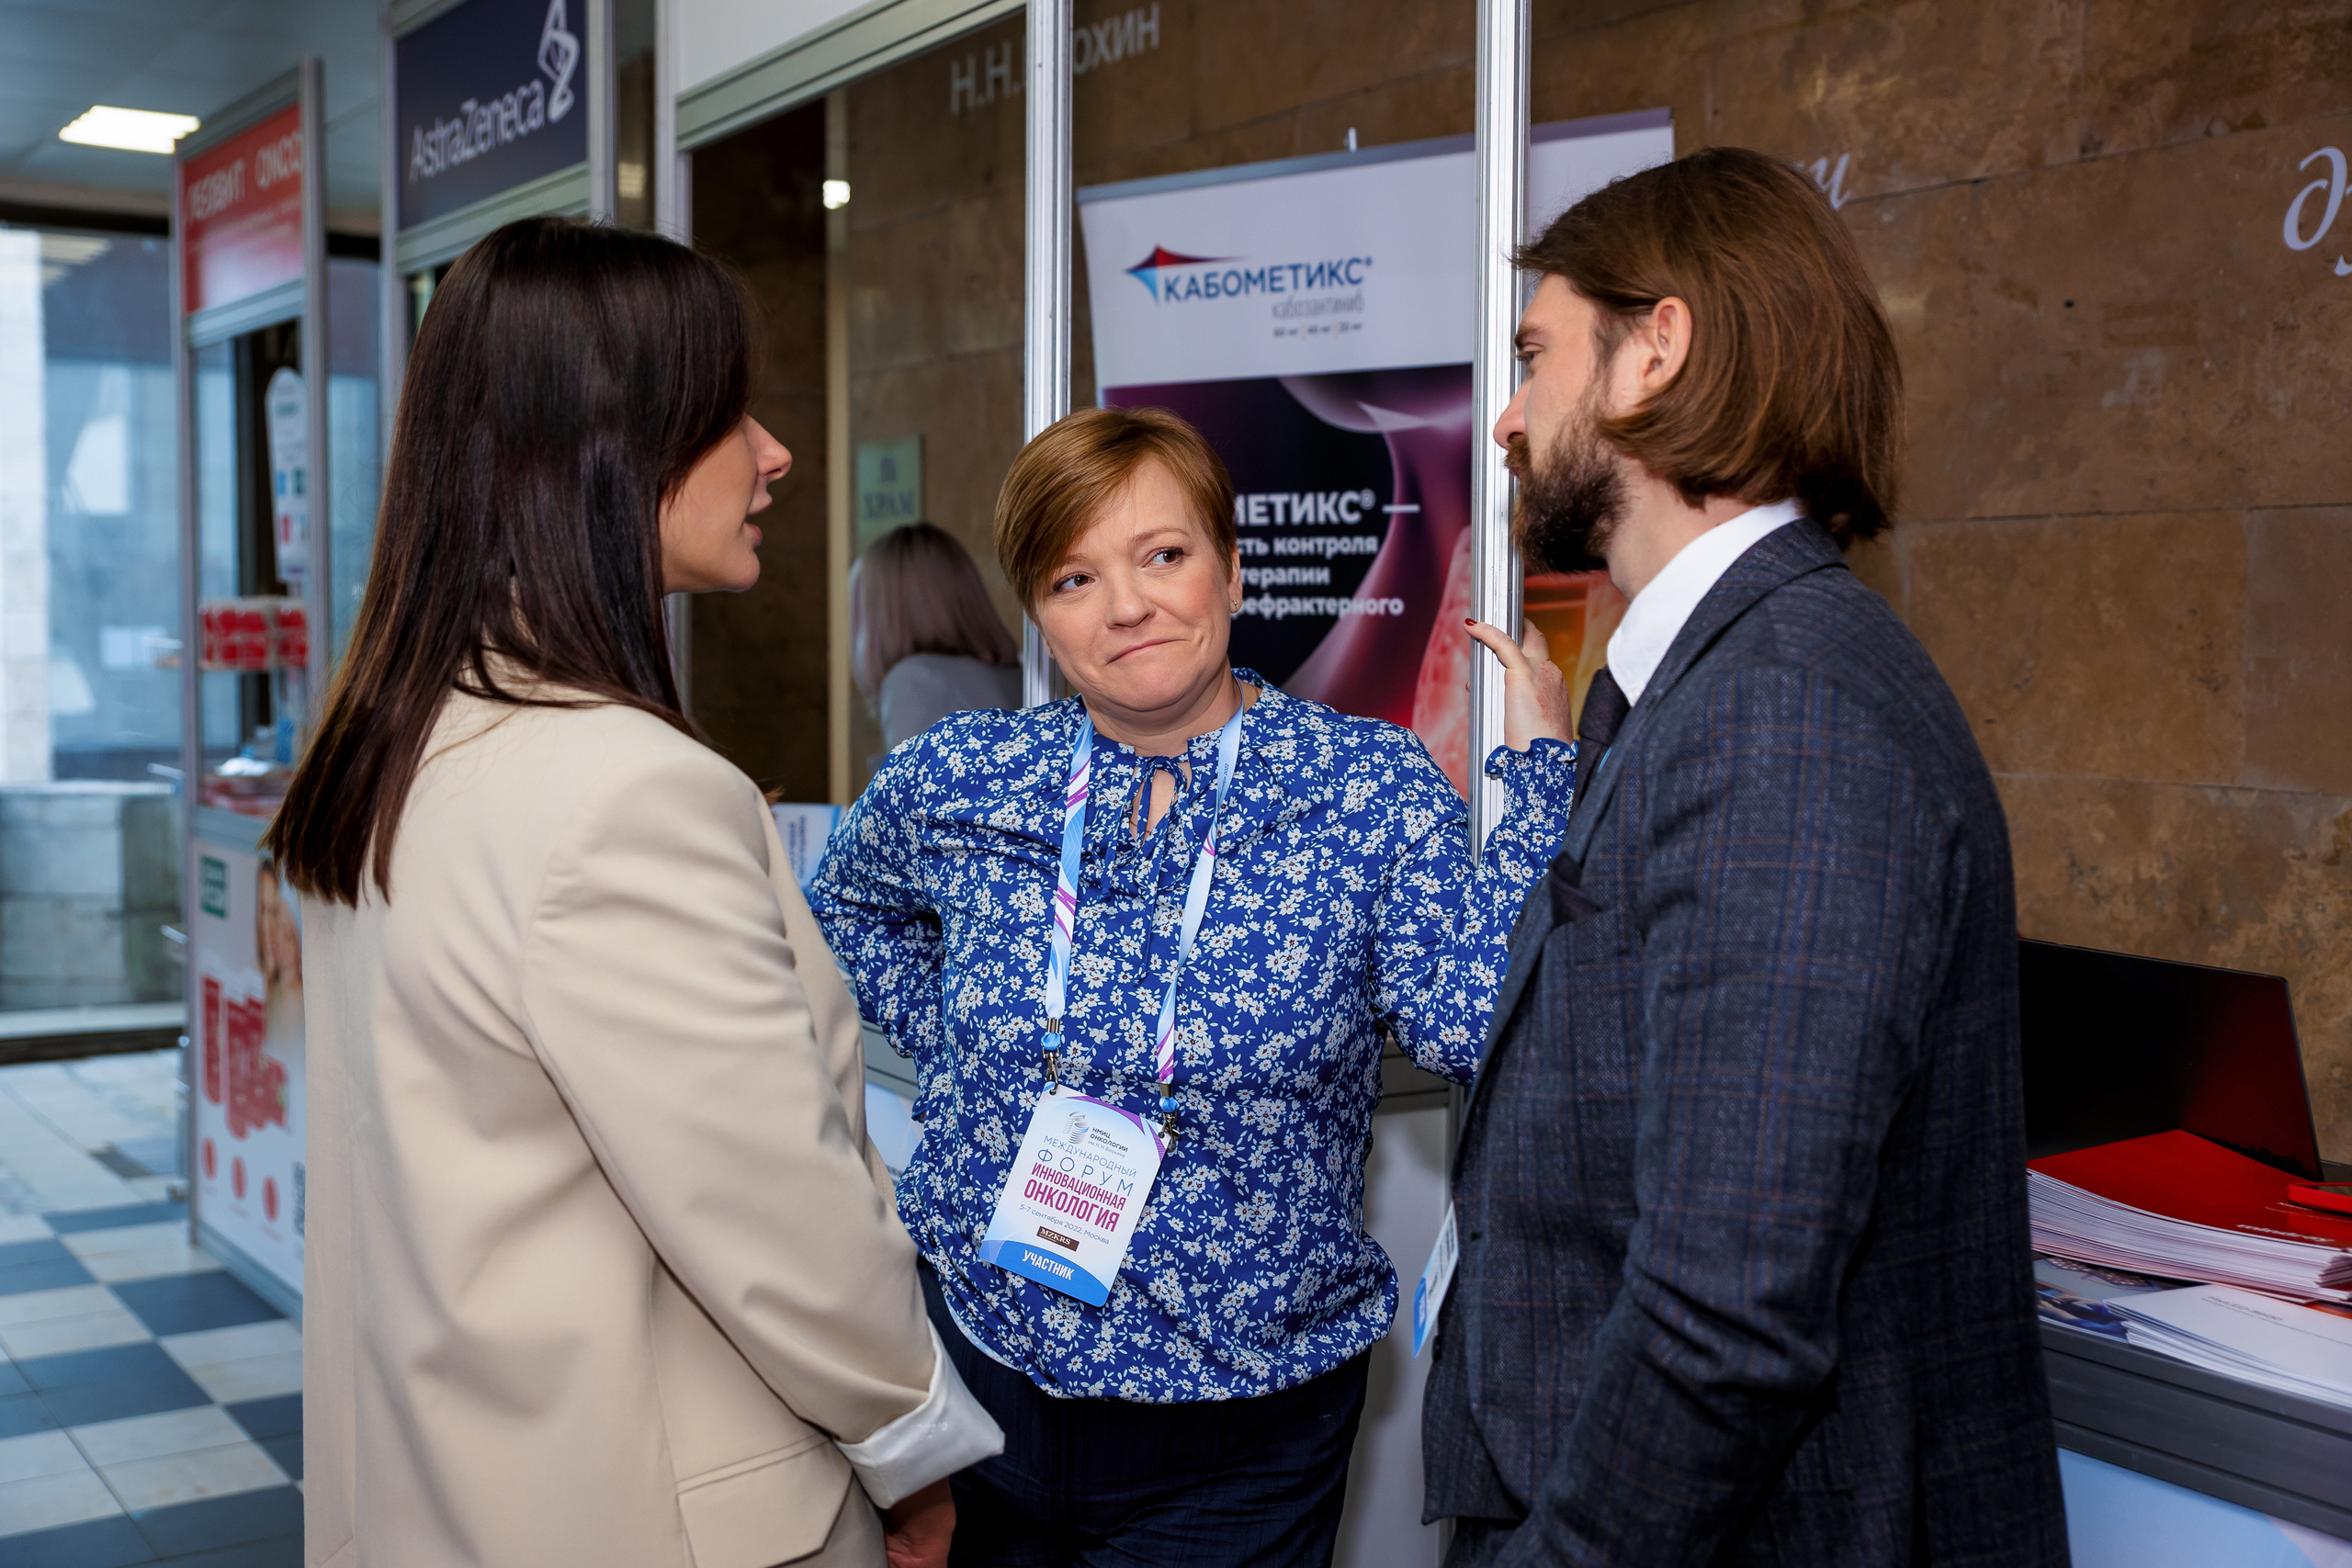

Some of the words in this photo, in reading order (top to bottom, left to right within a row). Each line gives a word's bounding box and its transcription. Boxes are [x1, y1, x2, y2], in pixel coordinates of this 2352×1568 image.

[409, 78, 546, 183] AstraZeneca
[1273, 536, 1378, 559] контроля
[1091, 1127, 1111, 1139] НМИЦ
[1037, 1149, 1134, 1197] ФОРУМ
[1044, 1135, 1137, 1179] МЕЖДУНАРОДНЫЙ
[1023, 1179, 1121, 1232] ОНКОЛОГИЯ
[1031, 1162, 1126, 1211] ИННОВАЦИОННАЯ
[1019, 1203, 1032, 1213] 5-7
[1031, 1209, 1064, 1225] сентября
[1083, 1229, 1110, 1245] Москва
[1040, 1227, 1071, 1246] MZKRS
[1022, 1249, 1075, 1280] УЧАСТНИК
